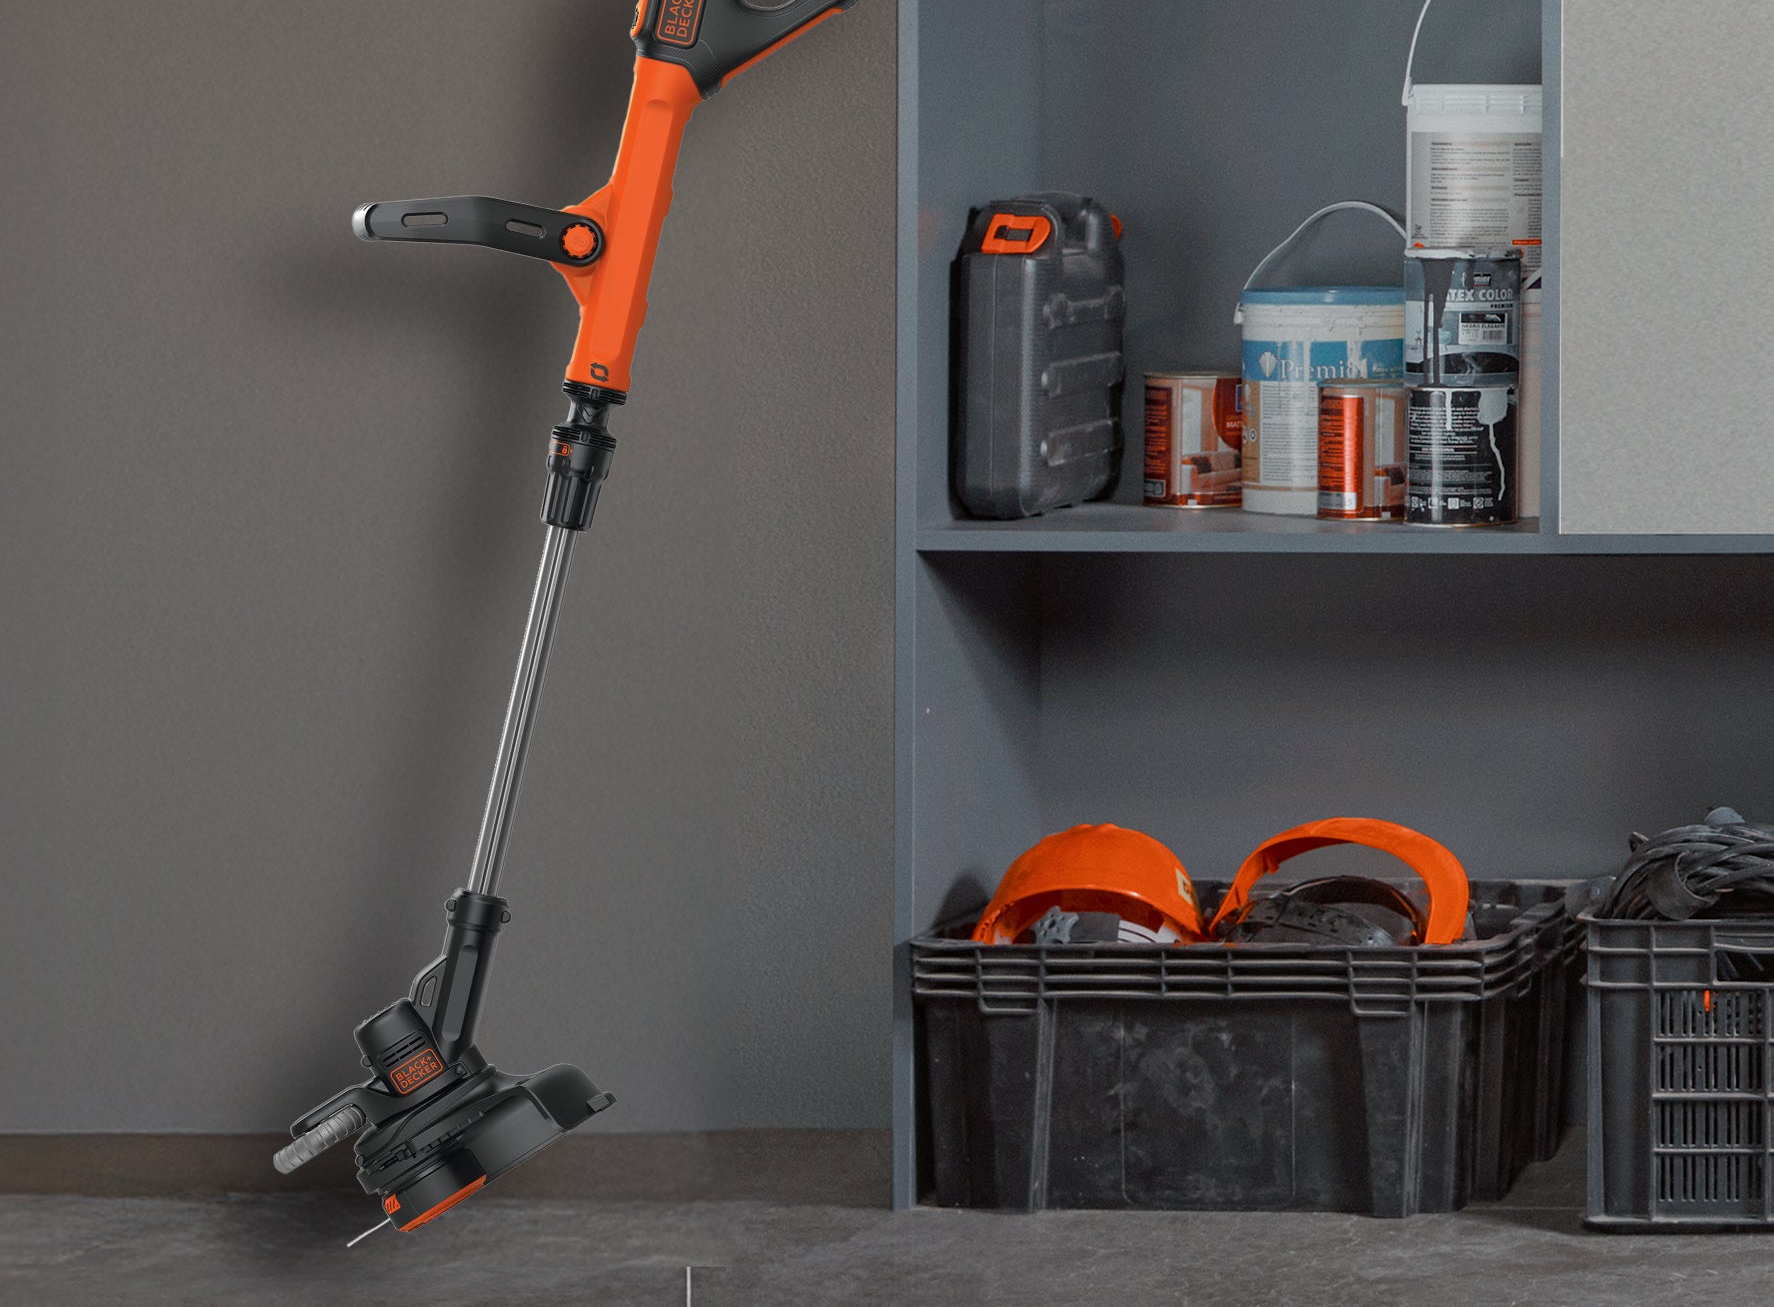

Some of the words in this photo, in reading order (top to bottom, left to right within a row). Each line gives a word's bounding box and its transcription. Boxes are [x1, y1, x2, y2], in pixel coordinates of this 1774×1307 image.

[1479, 288, 1514, 301] COLOR
[396, 1054, 432, 1081] BLACK+
[400, 1061, 437, 1088] DECKER
